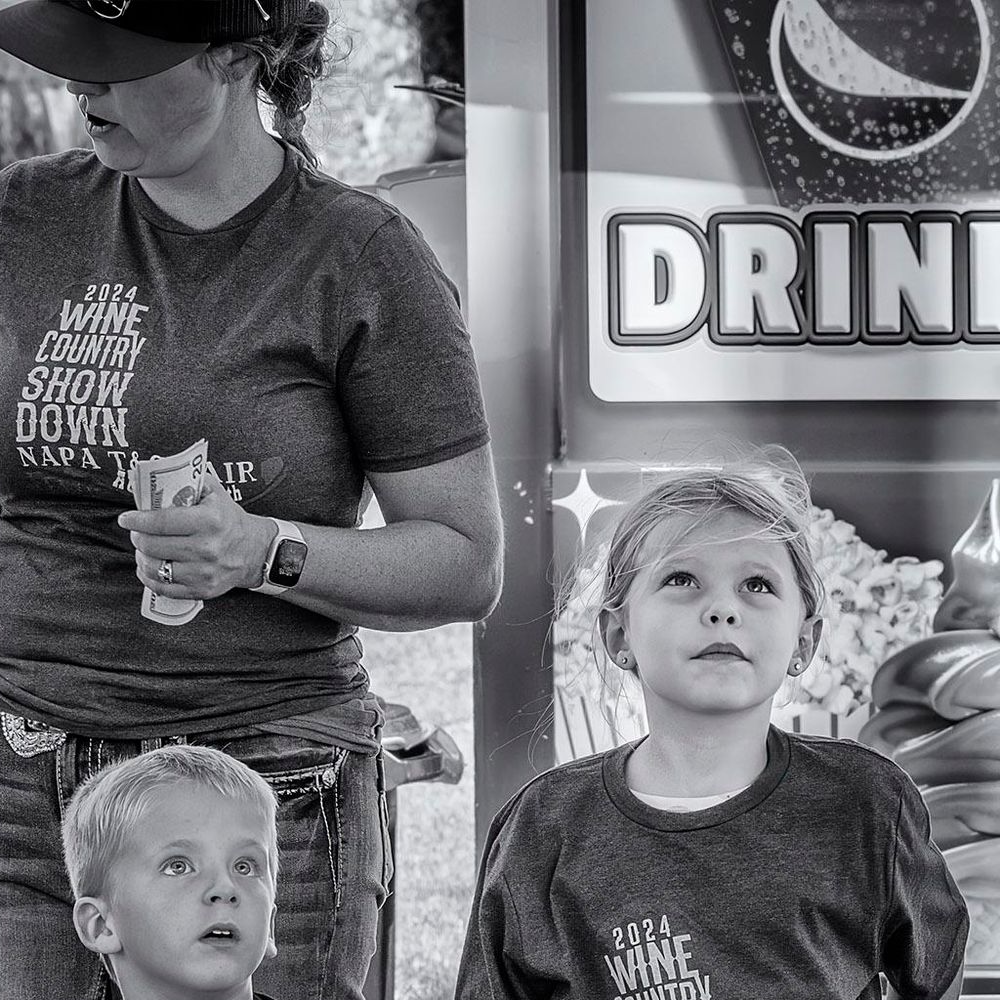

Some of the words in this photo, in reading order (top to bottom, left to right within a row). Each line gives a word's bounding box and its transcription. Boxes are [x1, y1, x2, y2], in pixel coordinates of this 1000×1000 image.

[84, 283, 138, 302] 2024
[60, 300, 149, 337] WINE
[35, 330, 146, 370] COUNTRY
[22, 365, 134, 407] SHOW
[16, 402, 129, 447] DOWN
[16, 446, 101, 470] NAPA
[612, 914, 671, 950] 2024
[604, 933, 699, 994] WINE
